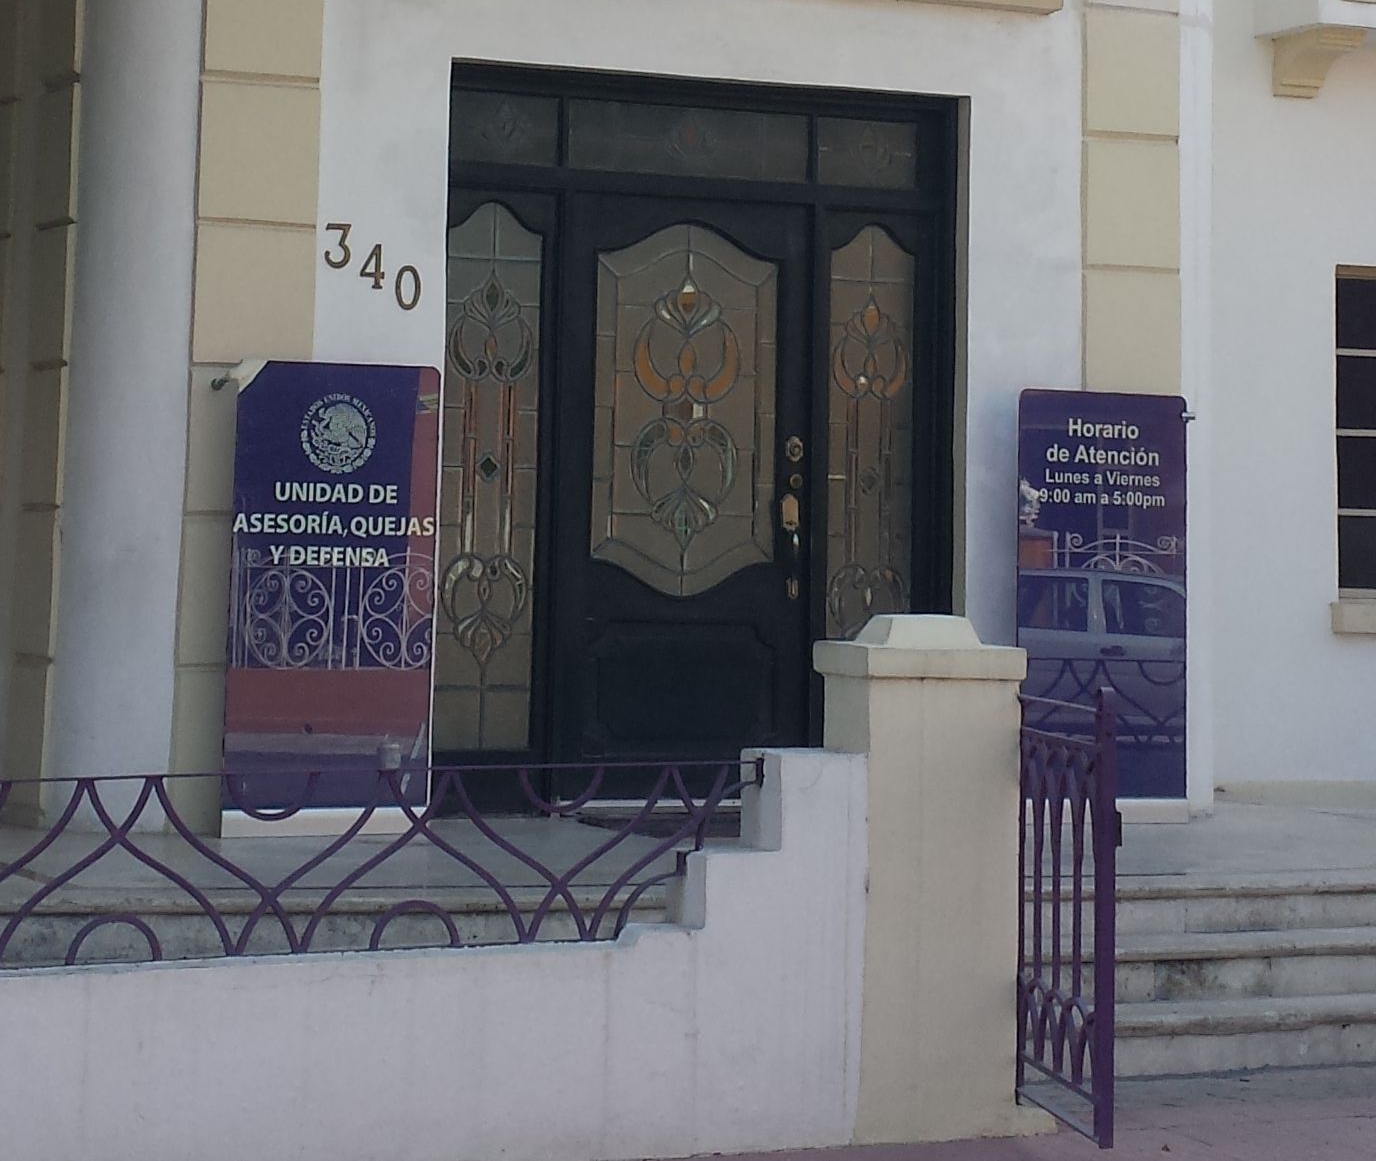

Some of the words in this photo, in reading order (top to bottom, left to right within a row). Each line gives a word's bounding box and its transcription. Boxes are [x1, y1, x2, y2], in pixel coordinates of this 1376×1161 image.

[324, 222, 422, 311] 340
[1068, 418, 1140, 439] Horario
[1046, 444, 1070, 462] de
[1074, 445, 1160, 466] Atención
[1045, 468, 1090, 484] Lunes
[1094, 473, 1103, 485] a
[1106, 470, 1161, 487] Viernes
[275, 482, 364, 503] UNIDAD
[369, 485, 398, 504] DE
[1039, 488, 1070, 503] 9:00
[1074, 493, 1097, 504] am
[1100, 493, 1109, 505] a
[1113, 491, 1165, 509] 5:00pm
[350, 516, 435, 538] QUEJAS
[270, 545, 285, 565] Y
[289, 546, 390, 567] DEFENSA
